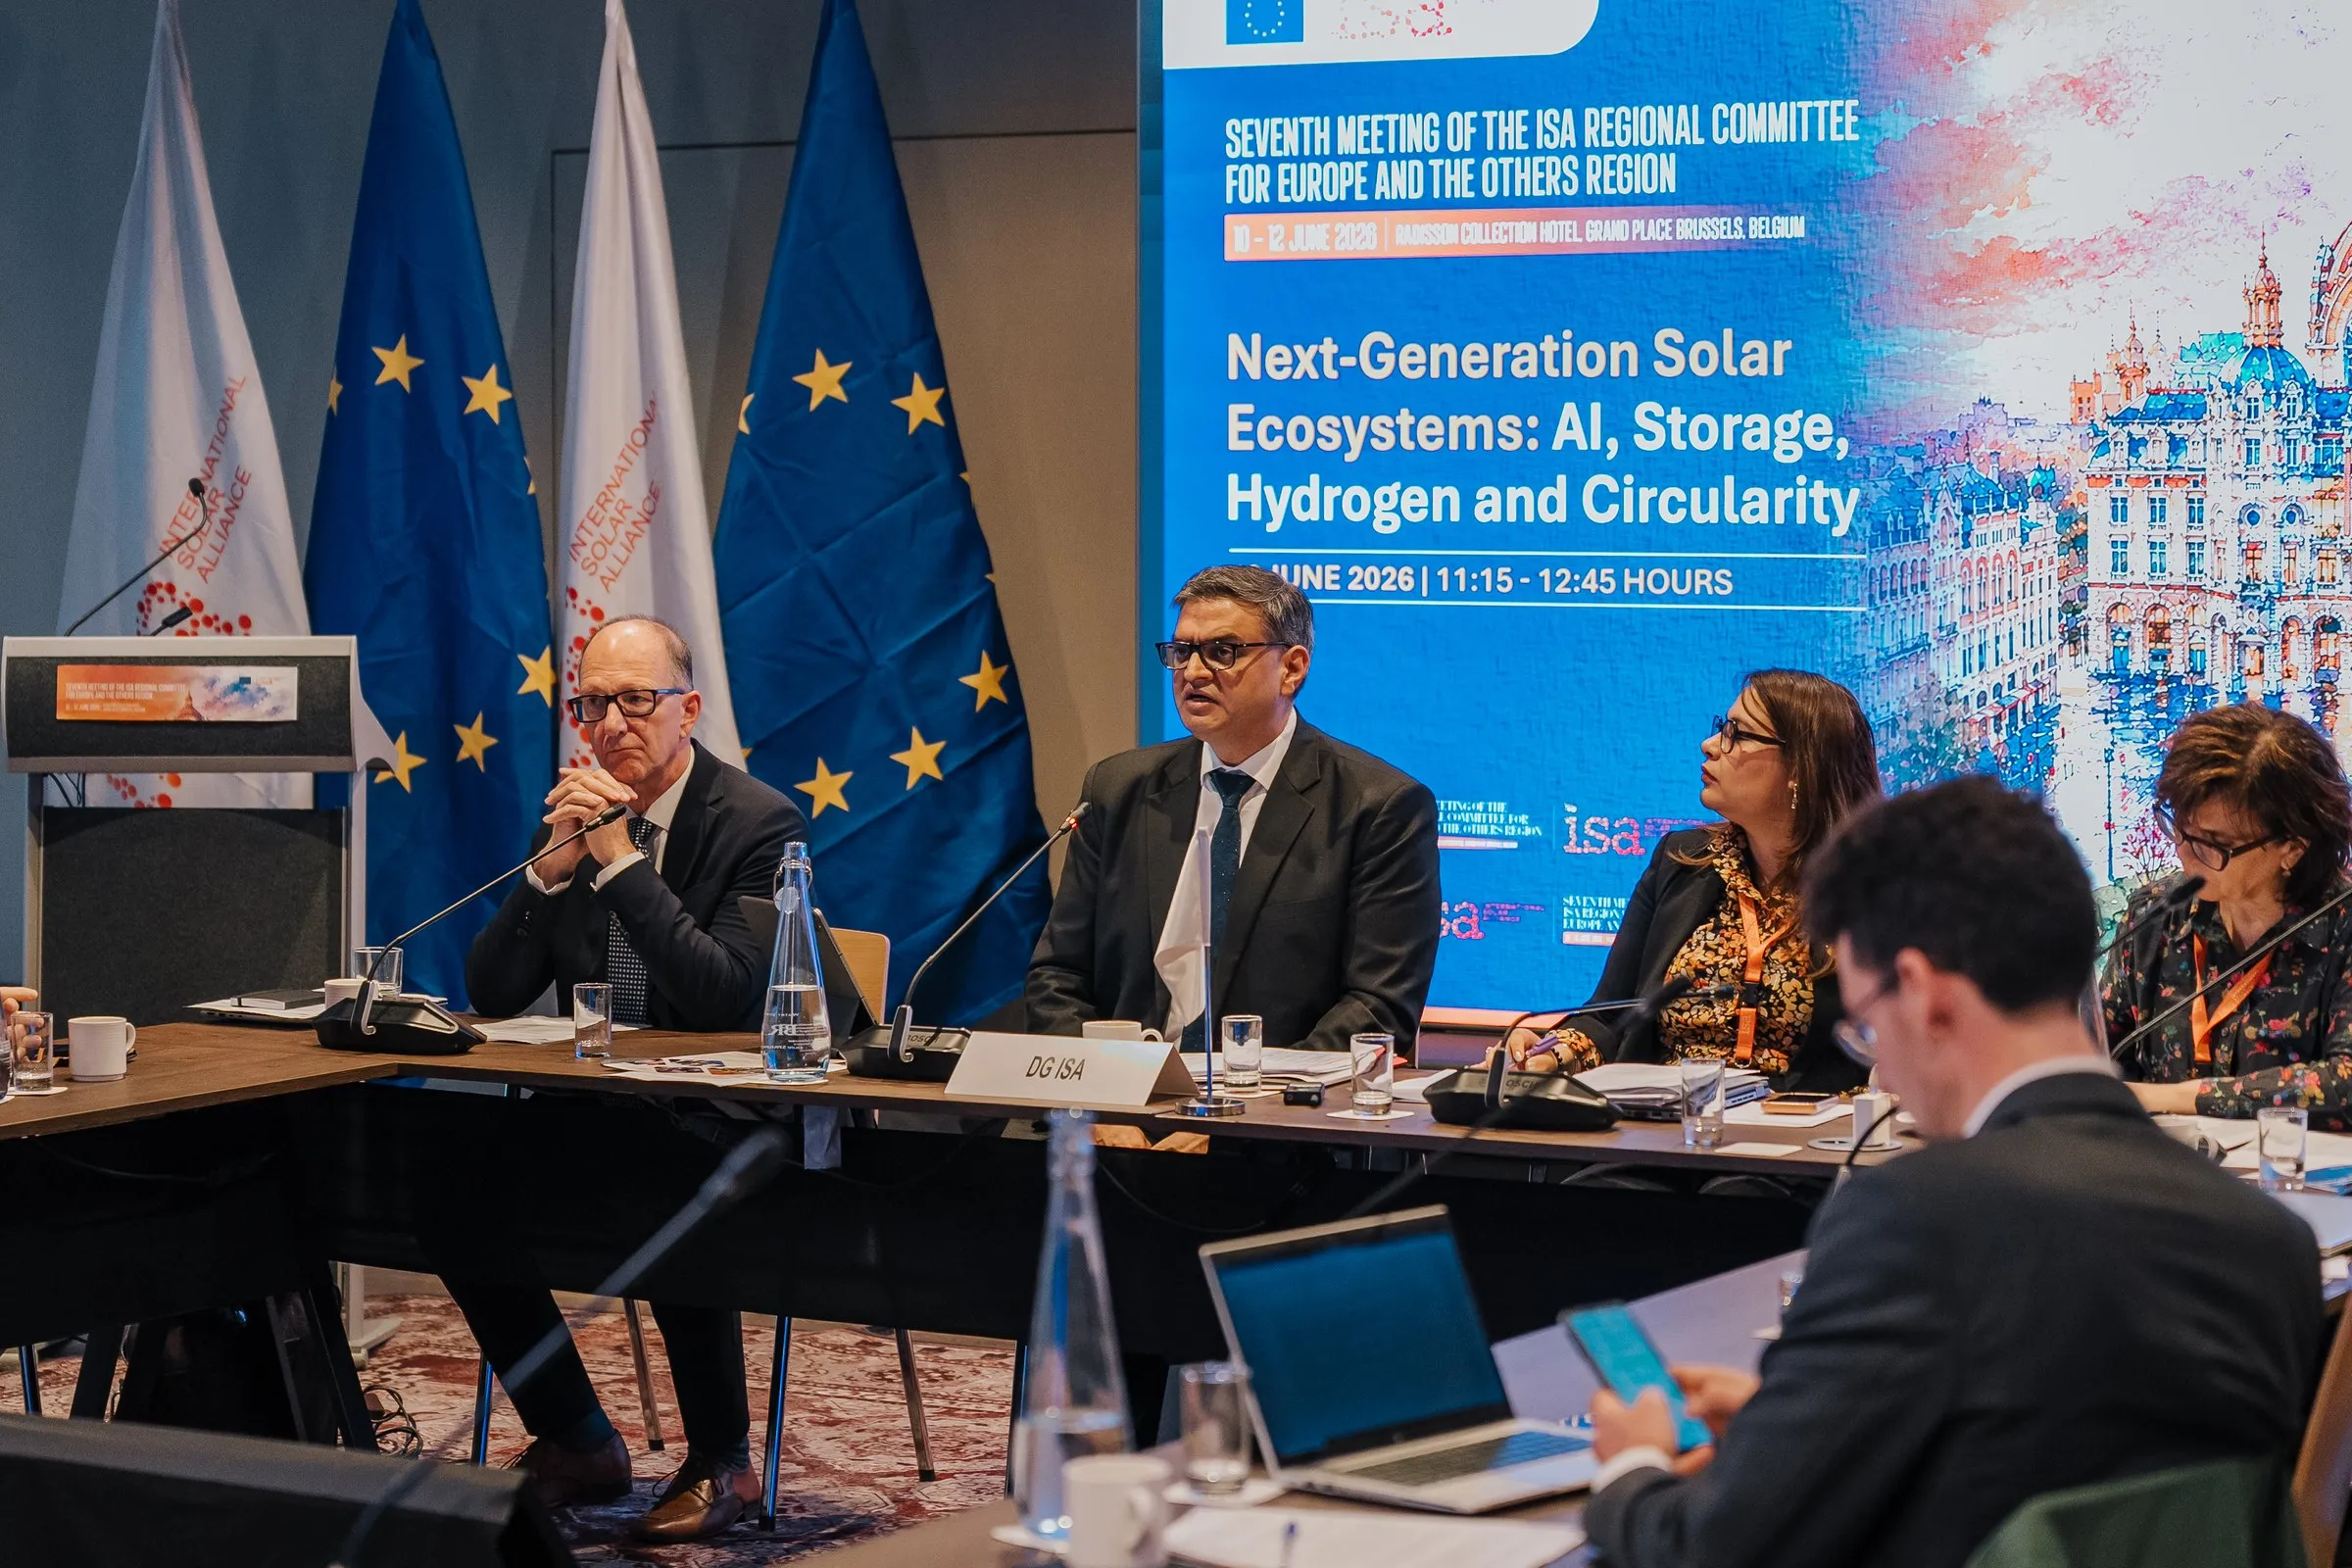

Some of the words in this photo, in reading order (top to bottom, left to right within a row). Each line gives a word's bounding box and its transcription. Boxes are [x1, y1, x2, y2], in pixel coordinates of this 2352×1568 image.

[1225, 116, 1330, 158] SEVENTH
[1337, 112, 1440, 155] MEETING
[1446, 111, 1477, 152] OF
[1482, 110, 1529, 150] THE
[1537, 108, 1576, 149] ISA
[1584, 104, 1704, 147] REGIONAL
[1712, 99, 1859, 145] COMMITTEE
[1226, 164, 1270, 204] FOR
[1278, 161, 1368, 203] EUROPE
[1374, 159, 1423, 200] AND
[1428, 158, 1475, 198] THE
[1482, 154, 1579, 198] OTHERS
[1586, 152, 1676, 195] REGION
[1233, 224, 1250, 253] 10
[1268, 223, 1285, 252] 12
[1289, 222, 1331, 252] JUNE
[1334, 221, 1378, 252] 2026
[1396, 222, 1458, 245] RADISSON
[1460, 220, 1537, 244] COLLECTION
[1586, 220, 1630, 242] GRAND
[1632, 218, 1673, 241] PLACE
[1748, 215, 1805, 239] BELGIUM
[1227, 330, 1639, 381] Next-Generation
[1652, 328, 1792, 378] Solar
[1227, 404, 1540, 463] Ecosystems:
[1551, 401, 1619, 461] AI,
[1634, 402, 1849, 464] Storage,
[177, 486, 225, 570] SOLAR
[197, 466, 252, 584] ALLIANCE
[1227, 473, 1461, 534] Hydrogen
[1474, 474, 1568, 524] and
[1582, 474, 1861, 537] Circularity
[581, 498, 632, 576] SOLAR
[599, 480, 661, 593] ALLIANCE
[1348, 564, 1415, 592] 2026
[1437, 566, 1514, 593] 11:15
[1539, 567, 1616, 594] 12:45
[1624, 568, 1734, 595] HOURS
[1562, 802, 1646, 856] isa
[1026, 1055, 1054, 1078] DG
[1054, 1058, 1086, 1081] ISA
